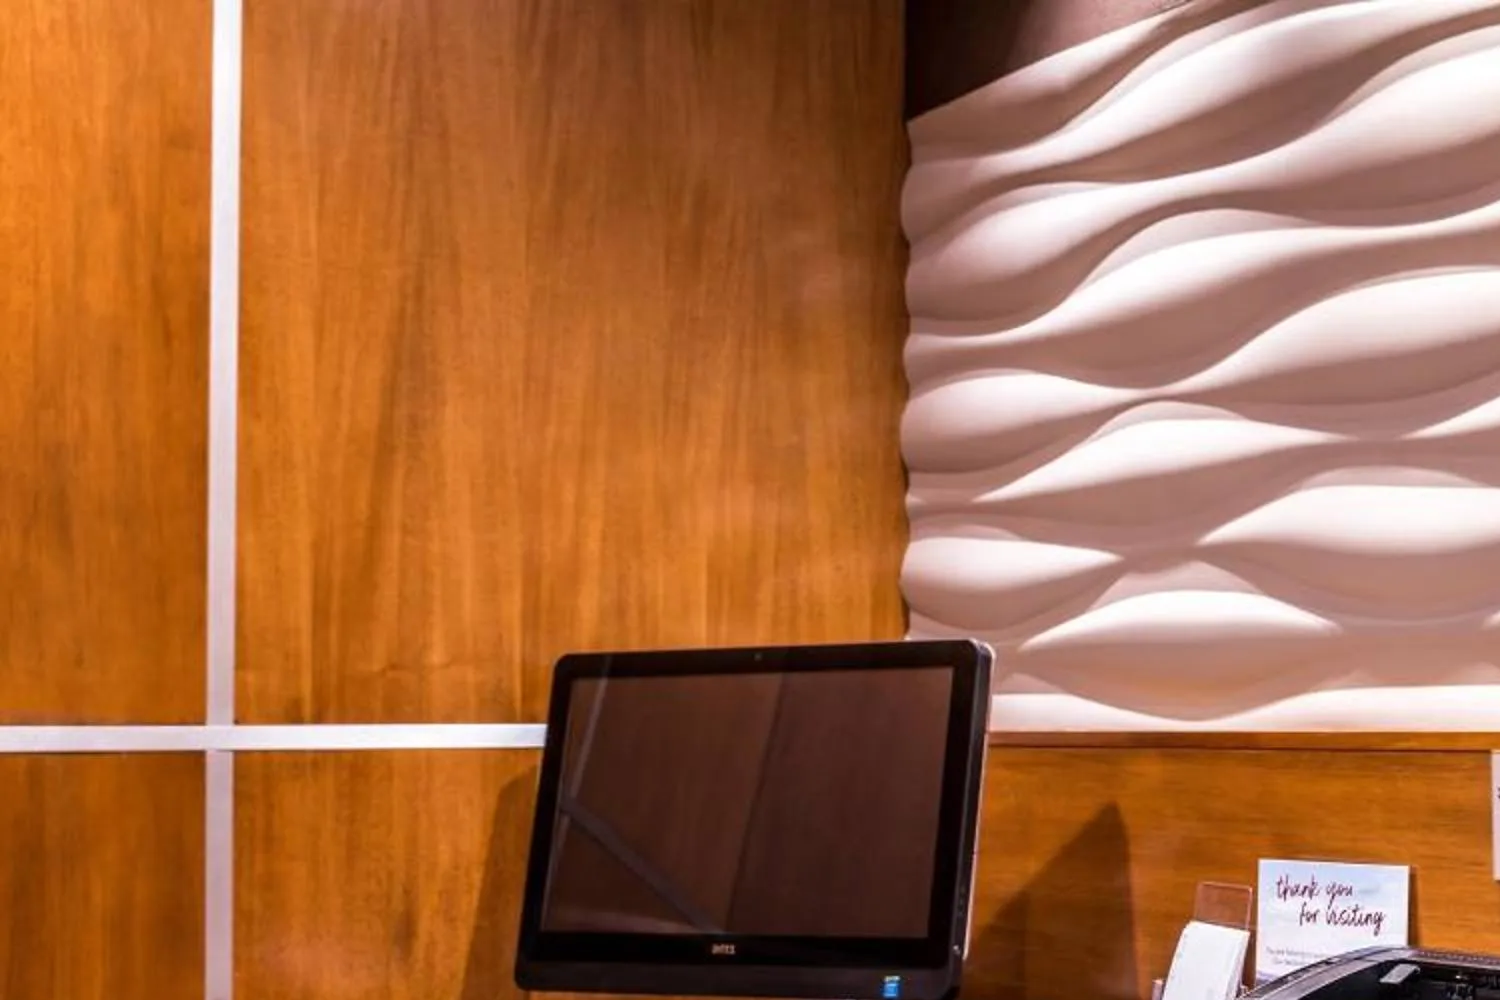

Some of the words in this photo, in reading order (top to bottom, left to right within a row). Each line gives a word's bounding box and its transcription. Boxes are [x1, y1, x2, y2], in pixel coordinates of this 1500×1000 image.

[1276, 872, 1320, 902] thank
[1325, 880, 1354, 909] you
[1299, 900, 1321, 927] for
